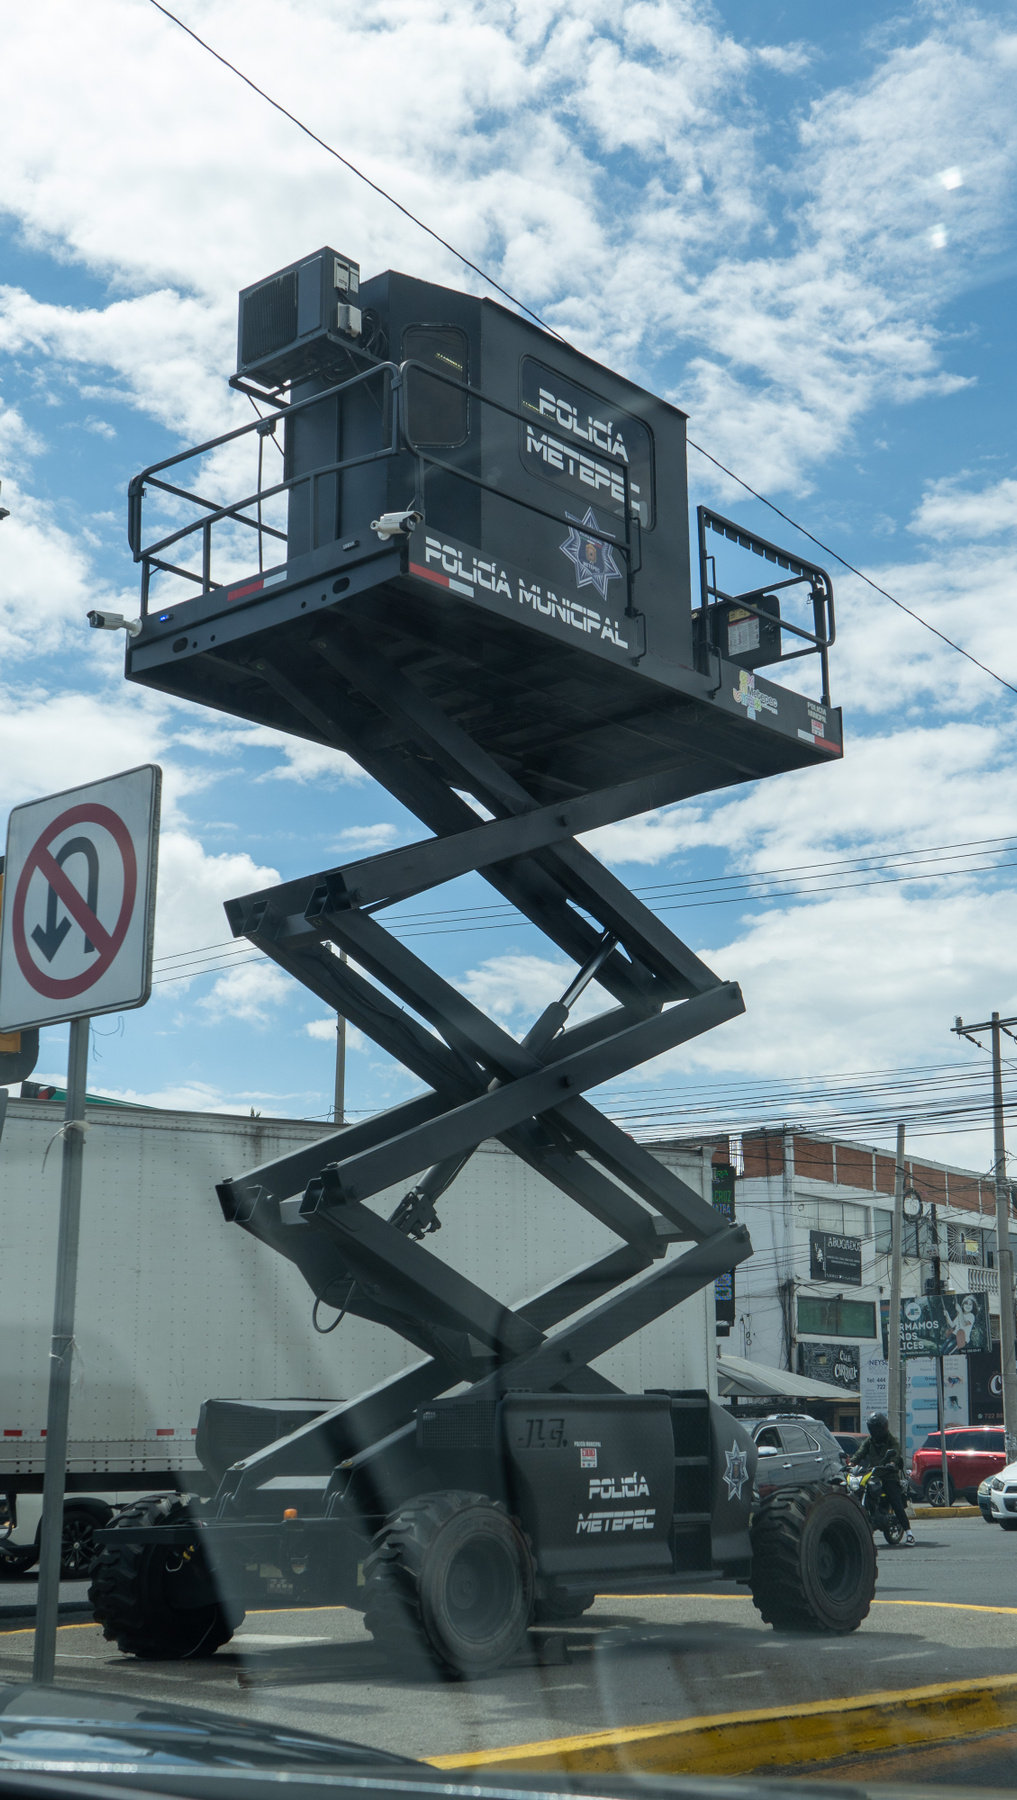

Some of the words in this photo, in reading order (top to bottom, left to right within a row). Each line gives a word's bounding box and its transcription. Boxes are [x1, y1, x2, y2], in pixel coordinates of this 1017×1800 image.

[539, 387, 629, 462] POLICÍA
[425, 536, 512, 599] POLICÍA
[518, 578, 629, 650] MUNICIPAL
[588, 1471, 650, 1500] POLICÍA
[576, 1508, 656, 1534] METEPEC
